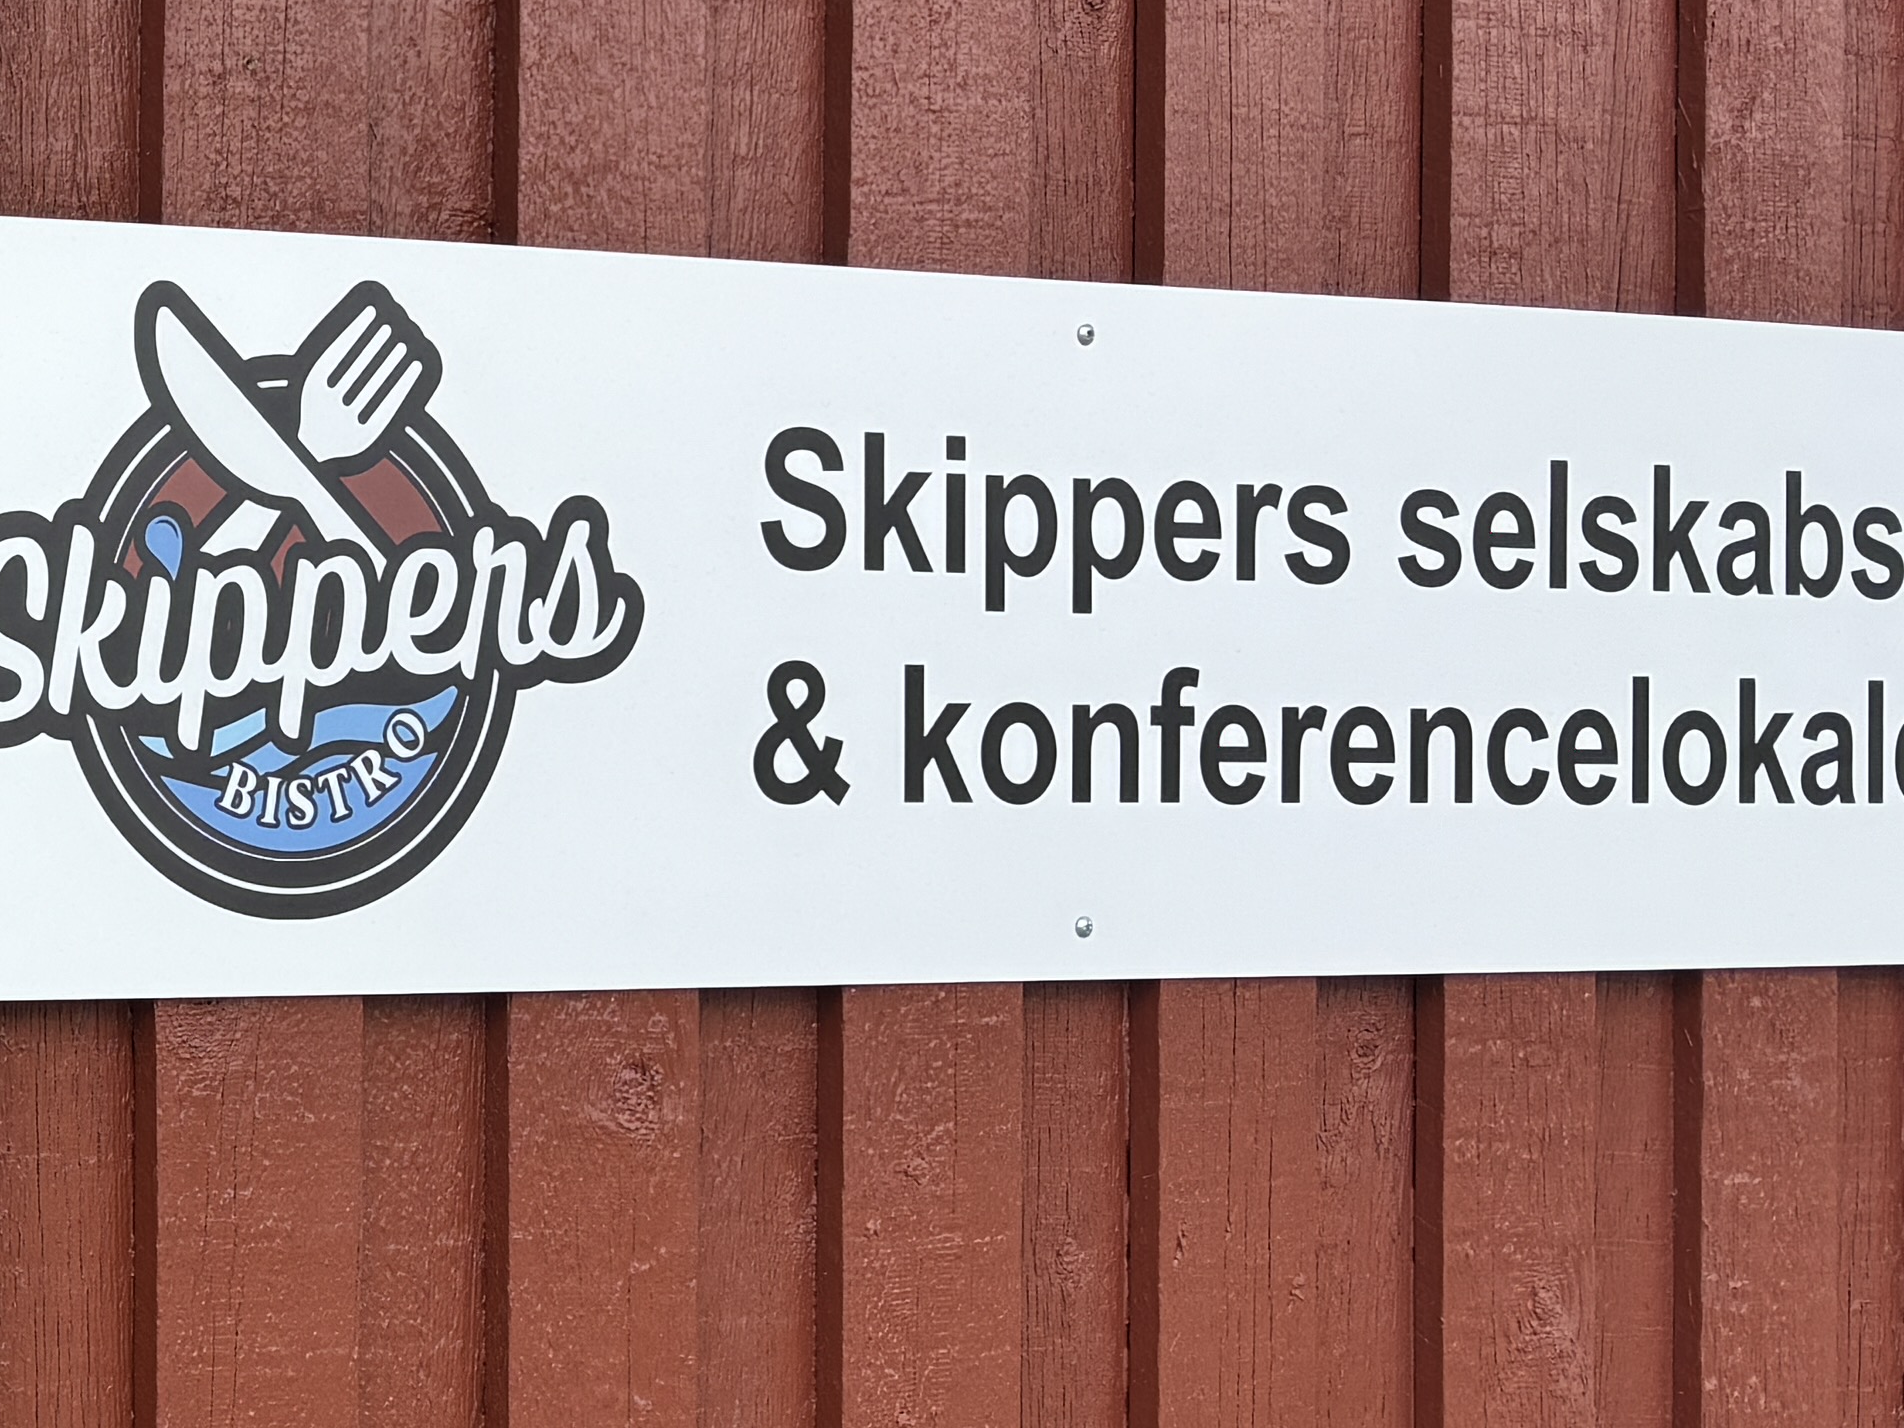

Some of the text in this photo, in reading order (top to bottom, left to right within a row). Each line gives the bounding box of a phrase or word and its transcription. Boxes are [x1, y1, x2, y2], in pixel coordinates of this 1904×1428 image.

[761, 427, 1904, 613] Skippers selskabs
[217, 710, 425, 827] BISTRO
[754, 661, 1904, 805] & konferencelokal
